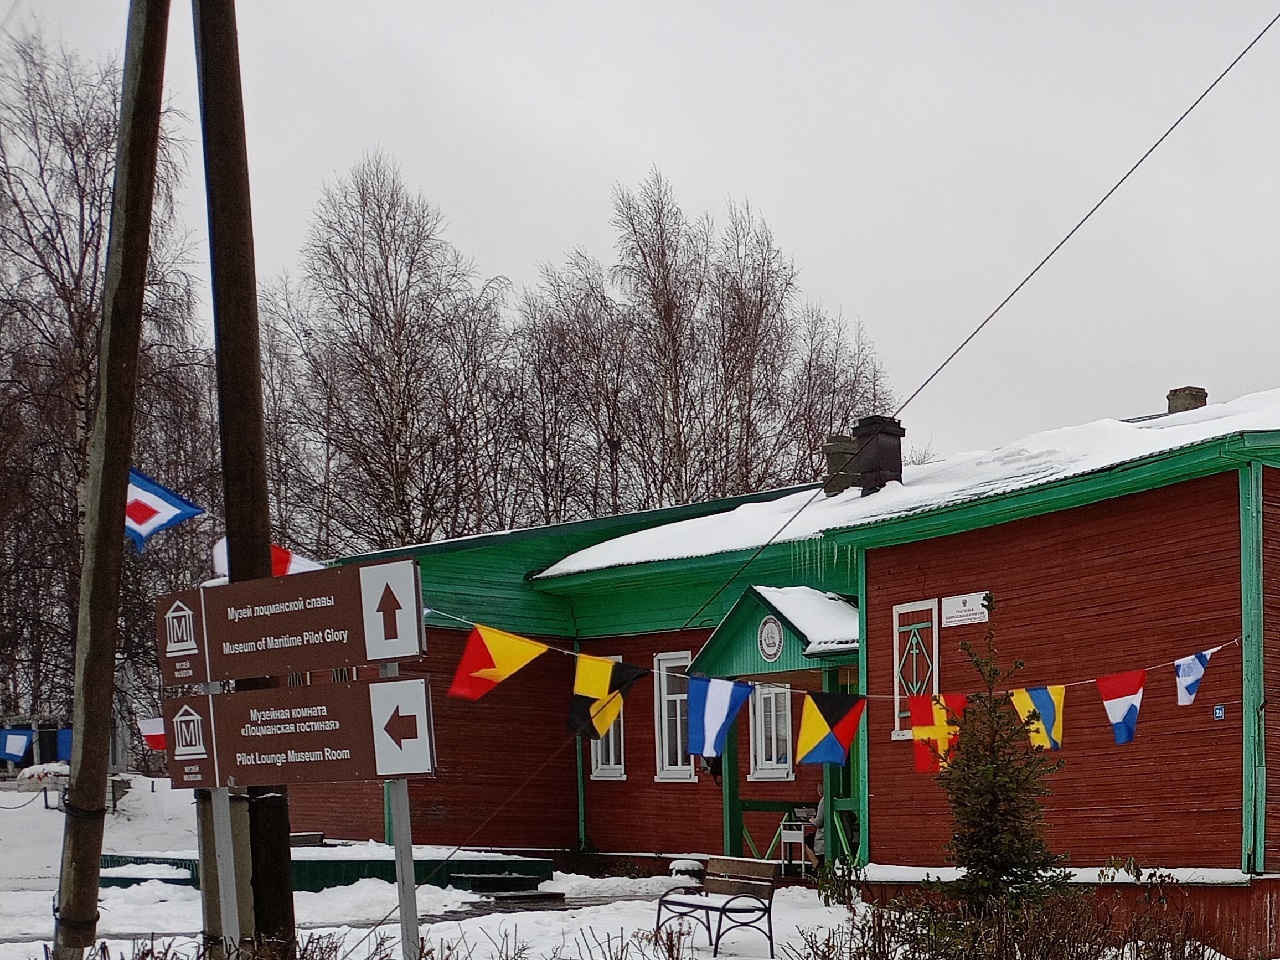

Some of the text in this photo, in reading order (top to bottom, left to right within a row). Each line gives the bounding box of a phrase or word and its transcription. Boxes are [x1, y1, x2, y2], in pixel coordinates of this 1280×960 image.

[227, 596, 334, 622] Музей лоцманской славы
[223, 628, 348, 654] Museum of Maritime Pilot Glory
[249, 705, 327, 724] Музейная комната
[241, 720, 340, 737] «Лоцманская гостиная»
[236, 747, 350, 767] Pilot Lounge Museum Room
